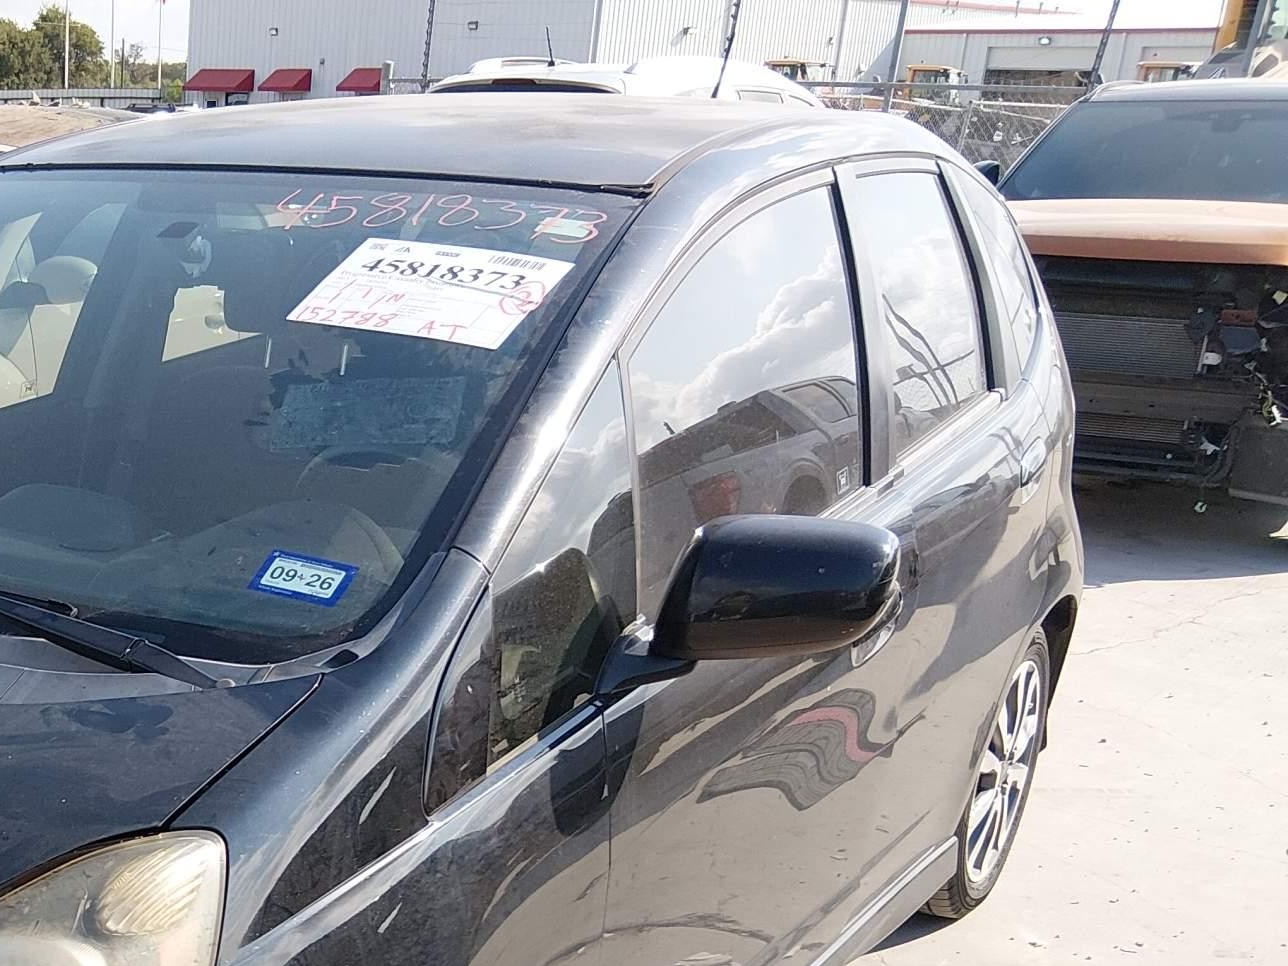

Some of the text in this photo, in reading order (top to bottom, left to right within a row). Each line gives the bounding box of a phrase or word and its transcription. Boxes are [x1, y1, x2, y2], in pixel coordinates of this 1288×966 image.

[275, 187, 608, 244] 45818373
[362, 257, 526, 290] 45818373
[269, 566, 298, 582] 09
[304, 573, 336, 591] 26
